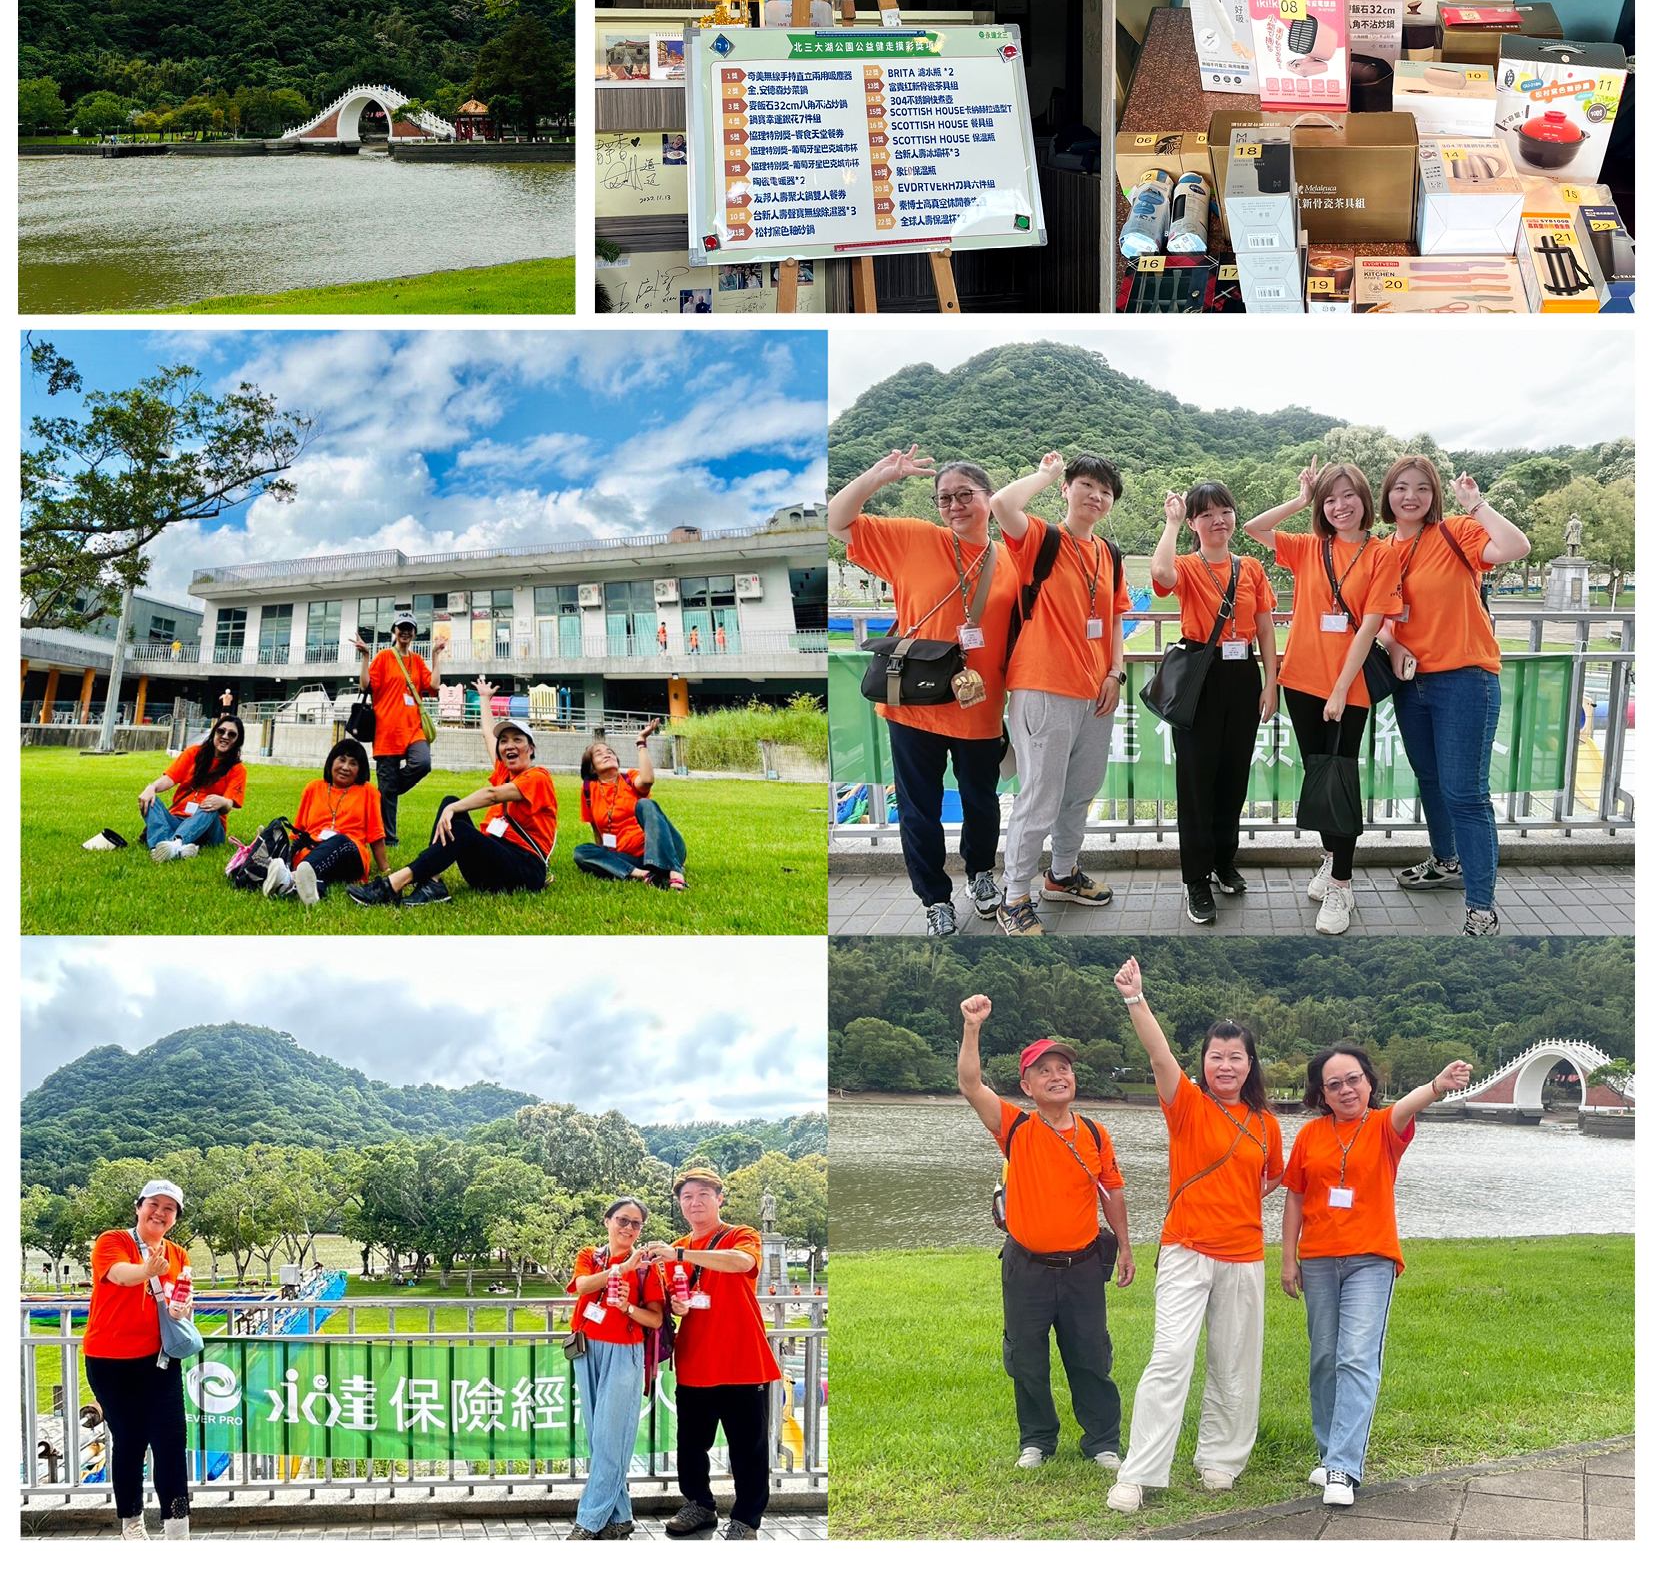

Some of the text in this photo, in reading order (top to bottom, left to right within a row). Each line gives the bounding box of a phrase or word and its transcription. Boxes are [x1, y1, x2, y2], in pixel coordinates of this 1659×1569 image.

[1280, 0, 1298, 14] 08
[1349, 4, 1396, 15] 飯石32cm
[887, 68, 916, 78] BRITA
[1599, 79, 1613, 92] 11
[890, 107, 933, 117] SCOTTISH
[891, 118, 994, 130] SCOTTISH HOUSE 餐具組
[892, 133, 996, 146] SCOTTISH HOUSE 保溫瓶
[1237, 147, 1257, 156] 18
[1304, 184, 1337, 192] Melaleuca
[1564, 189, 1578, 199] 15
[1592, 222, 1611, 231] 22
[1554, 233, 1571, 242] 21
[1141, 259, 1159, 268] 16
[1221, 268, 1239, 277] 17
[1310, 280, 1329, 290] 19
[1384, 280, 1403, 289] 20
[186, 1413, 243, 1426] EVER PRO
